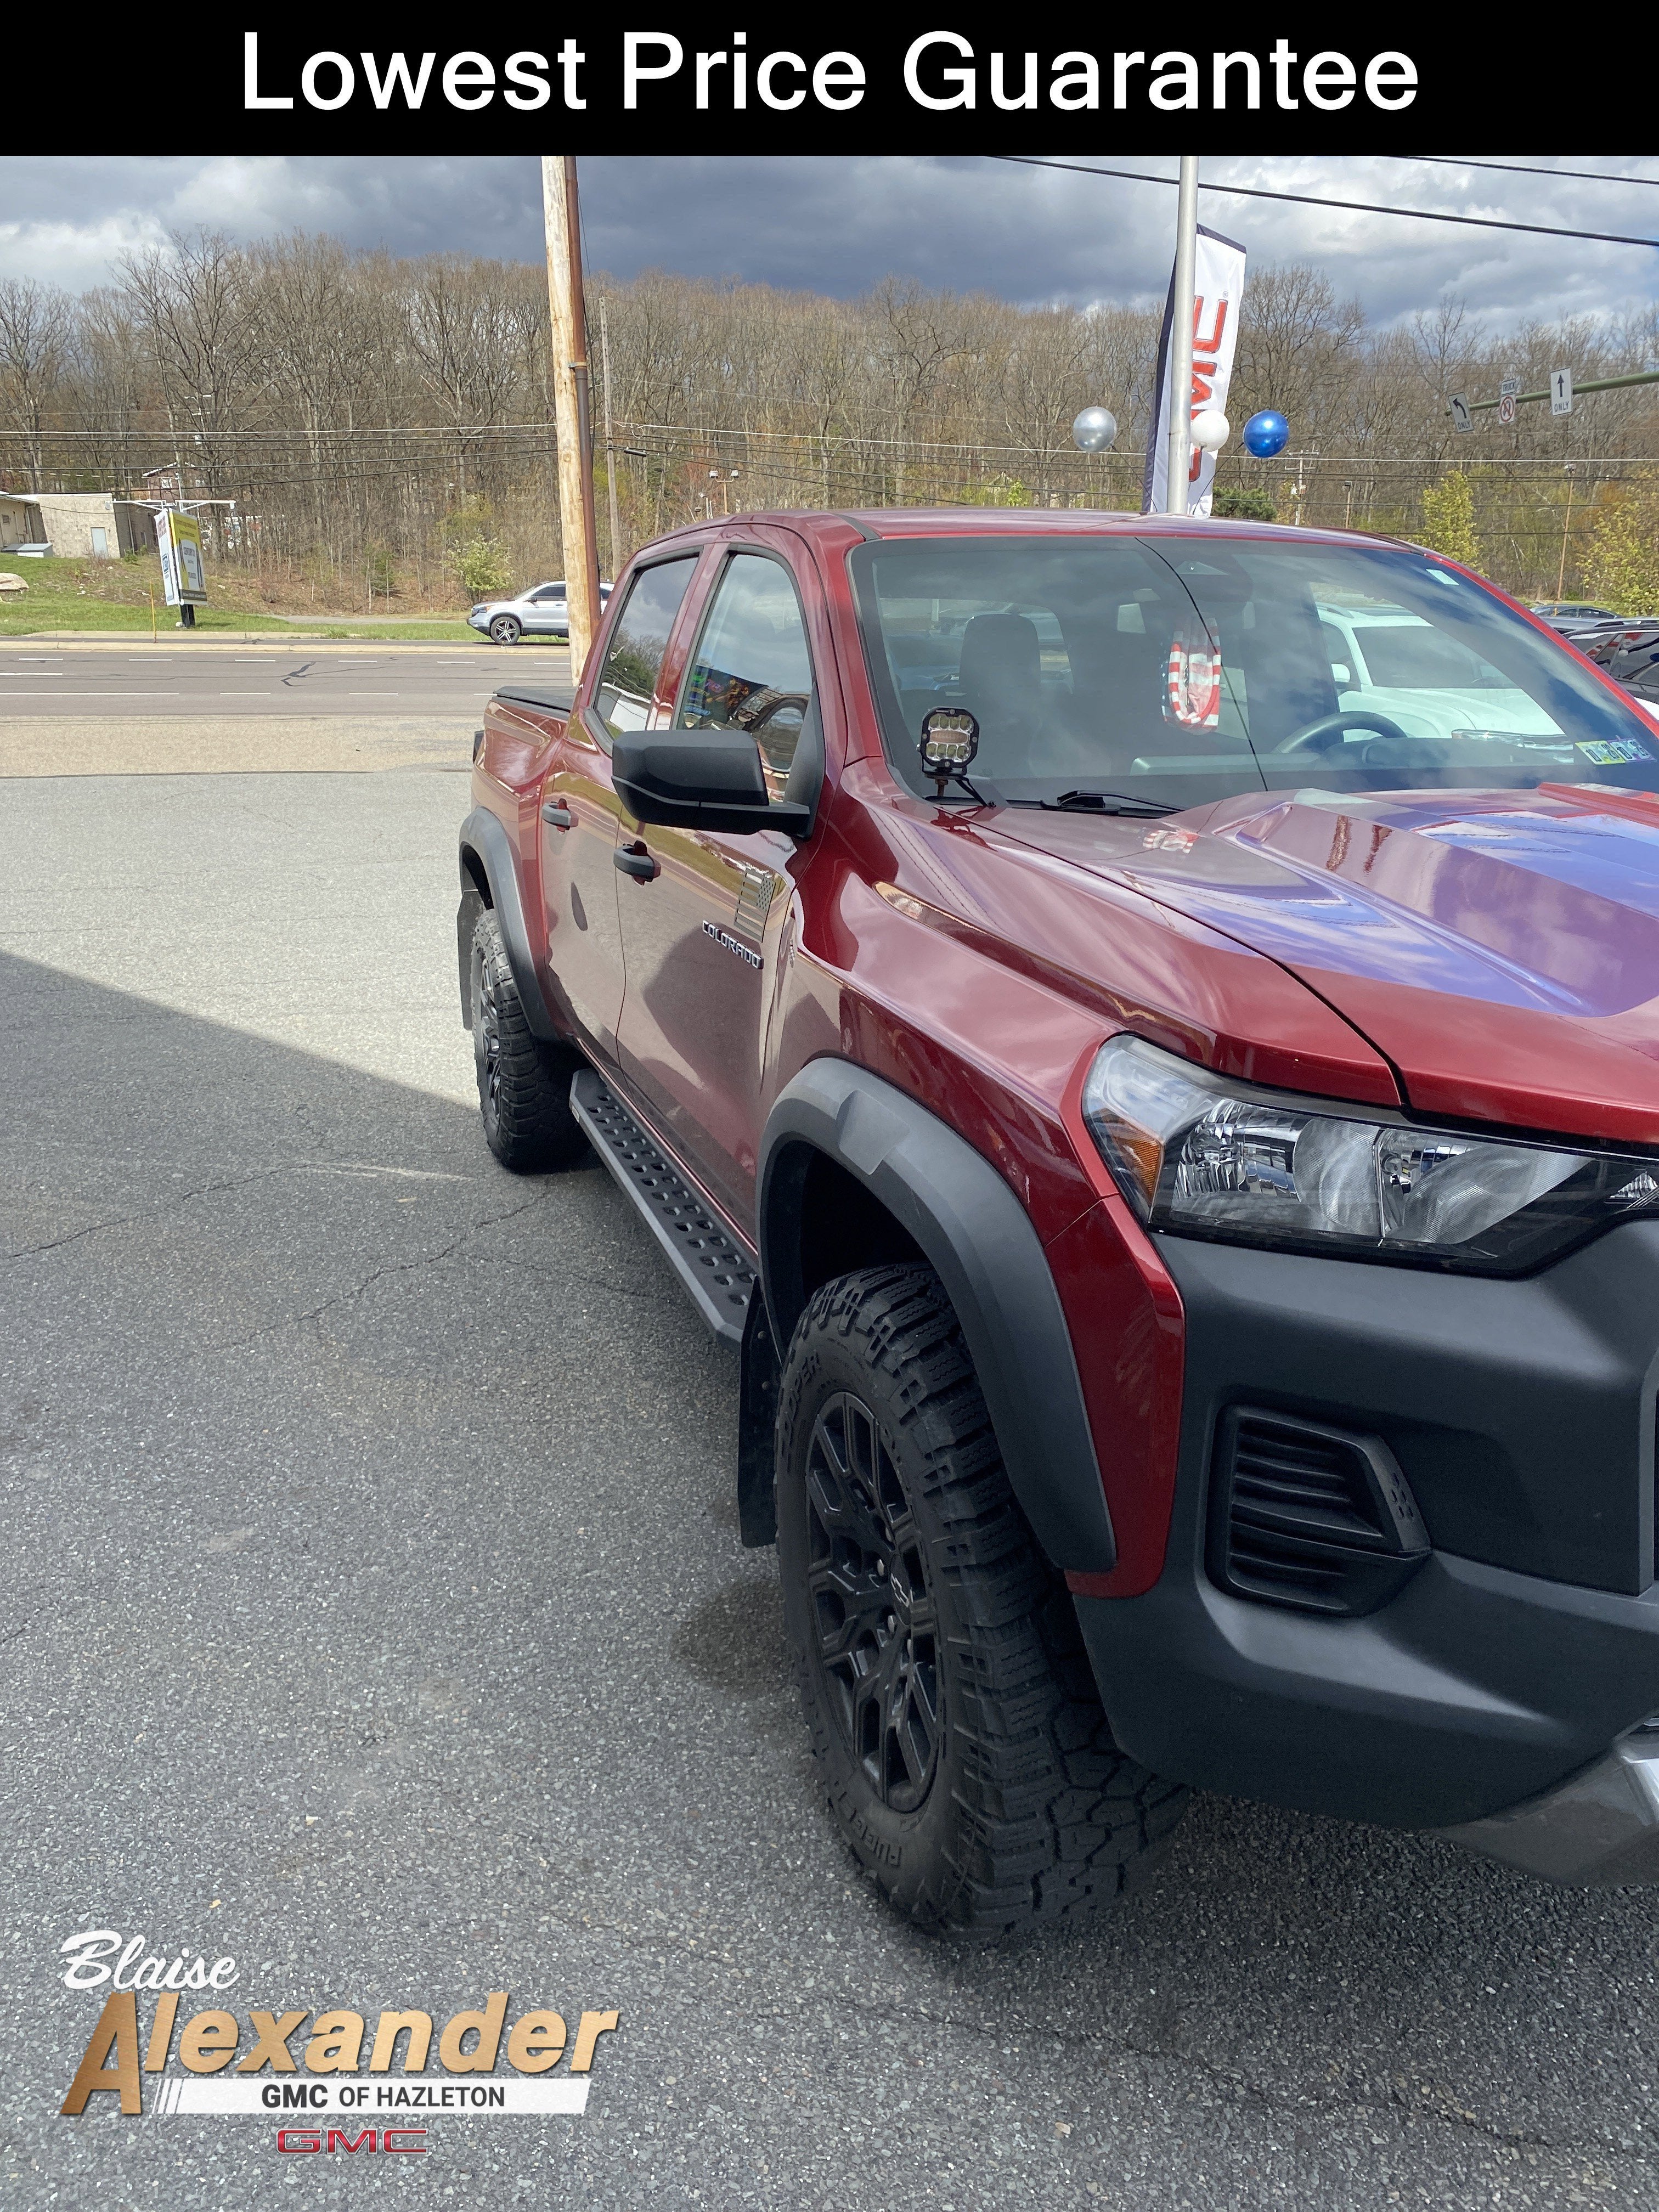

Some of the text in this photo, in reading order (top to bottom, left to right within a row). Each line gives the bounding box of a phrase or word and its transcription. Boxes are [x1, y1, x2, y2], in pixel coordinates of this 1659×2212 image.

[1554, 400, 1570, 413] ONLY
[1458, 421, 1471, 430] ONLY
[702, 920, 763, 969] COLORADO
